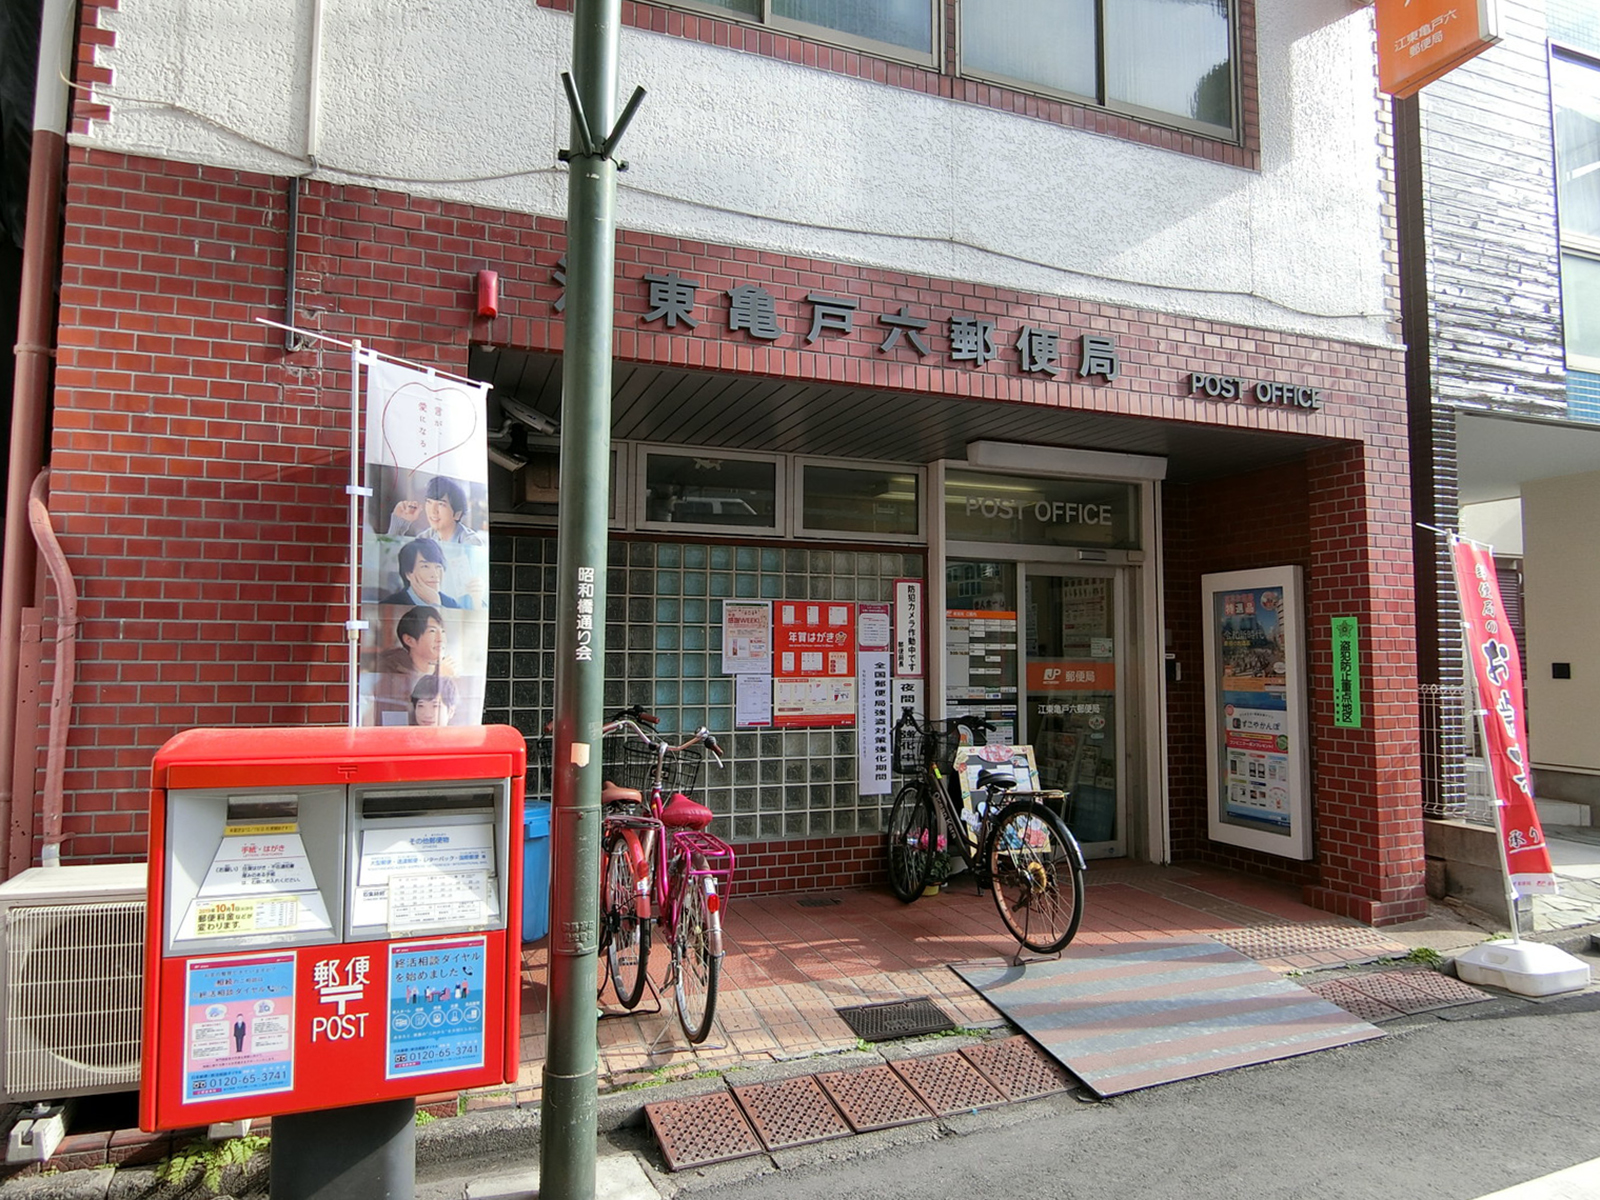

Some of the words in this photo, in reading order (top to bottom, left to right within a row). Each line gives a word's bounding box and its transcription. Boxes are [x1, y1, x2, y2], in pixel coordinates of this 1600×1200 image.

[1394, 9, 1457, 52] 江東亀戸六
[1409, 30, 1443, 58] 郵便局
[553, 257, 1119, 382] 東亀戸六郵便局
[1190, 372, 1246, 398] POST
[1255, 381, 1321, 410] OFFICE
[965, 497, 1025, 520] POST
[1034, 501, 1112, 525] OFFICE
[576, 567, 594, 661] 昭和橋通り会
[908, 585, 916, 671] 防犯カメラ作動中です
[789, 631, 834, 643] 年賀はがき
[1065, 670, 1095, 683] 郵便局
[874, 662, 887, 781] 全国郵便局強盗対策強化期間
[313, 955, 371, 990] 郵便
[394, 952, 481, 969] 終活相談ダイヤル
[395, 968, 459, 983] を始めました
[312, 1012, 369, 1043] POST
[409, 1045, 478, 1061] 0120-65-3741
[209, 1071, 287, 1088] 0120-65-3741
